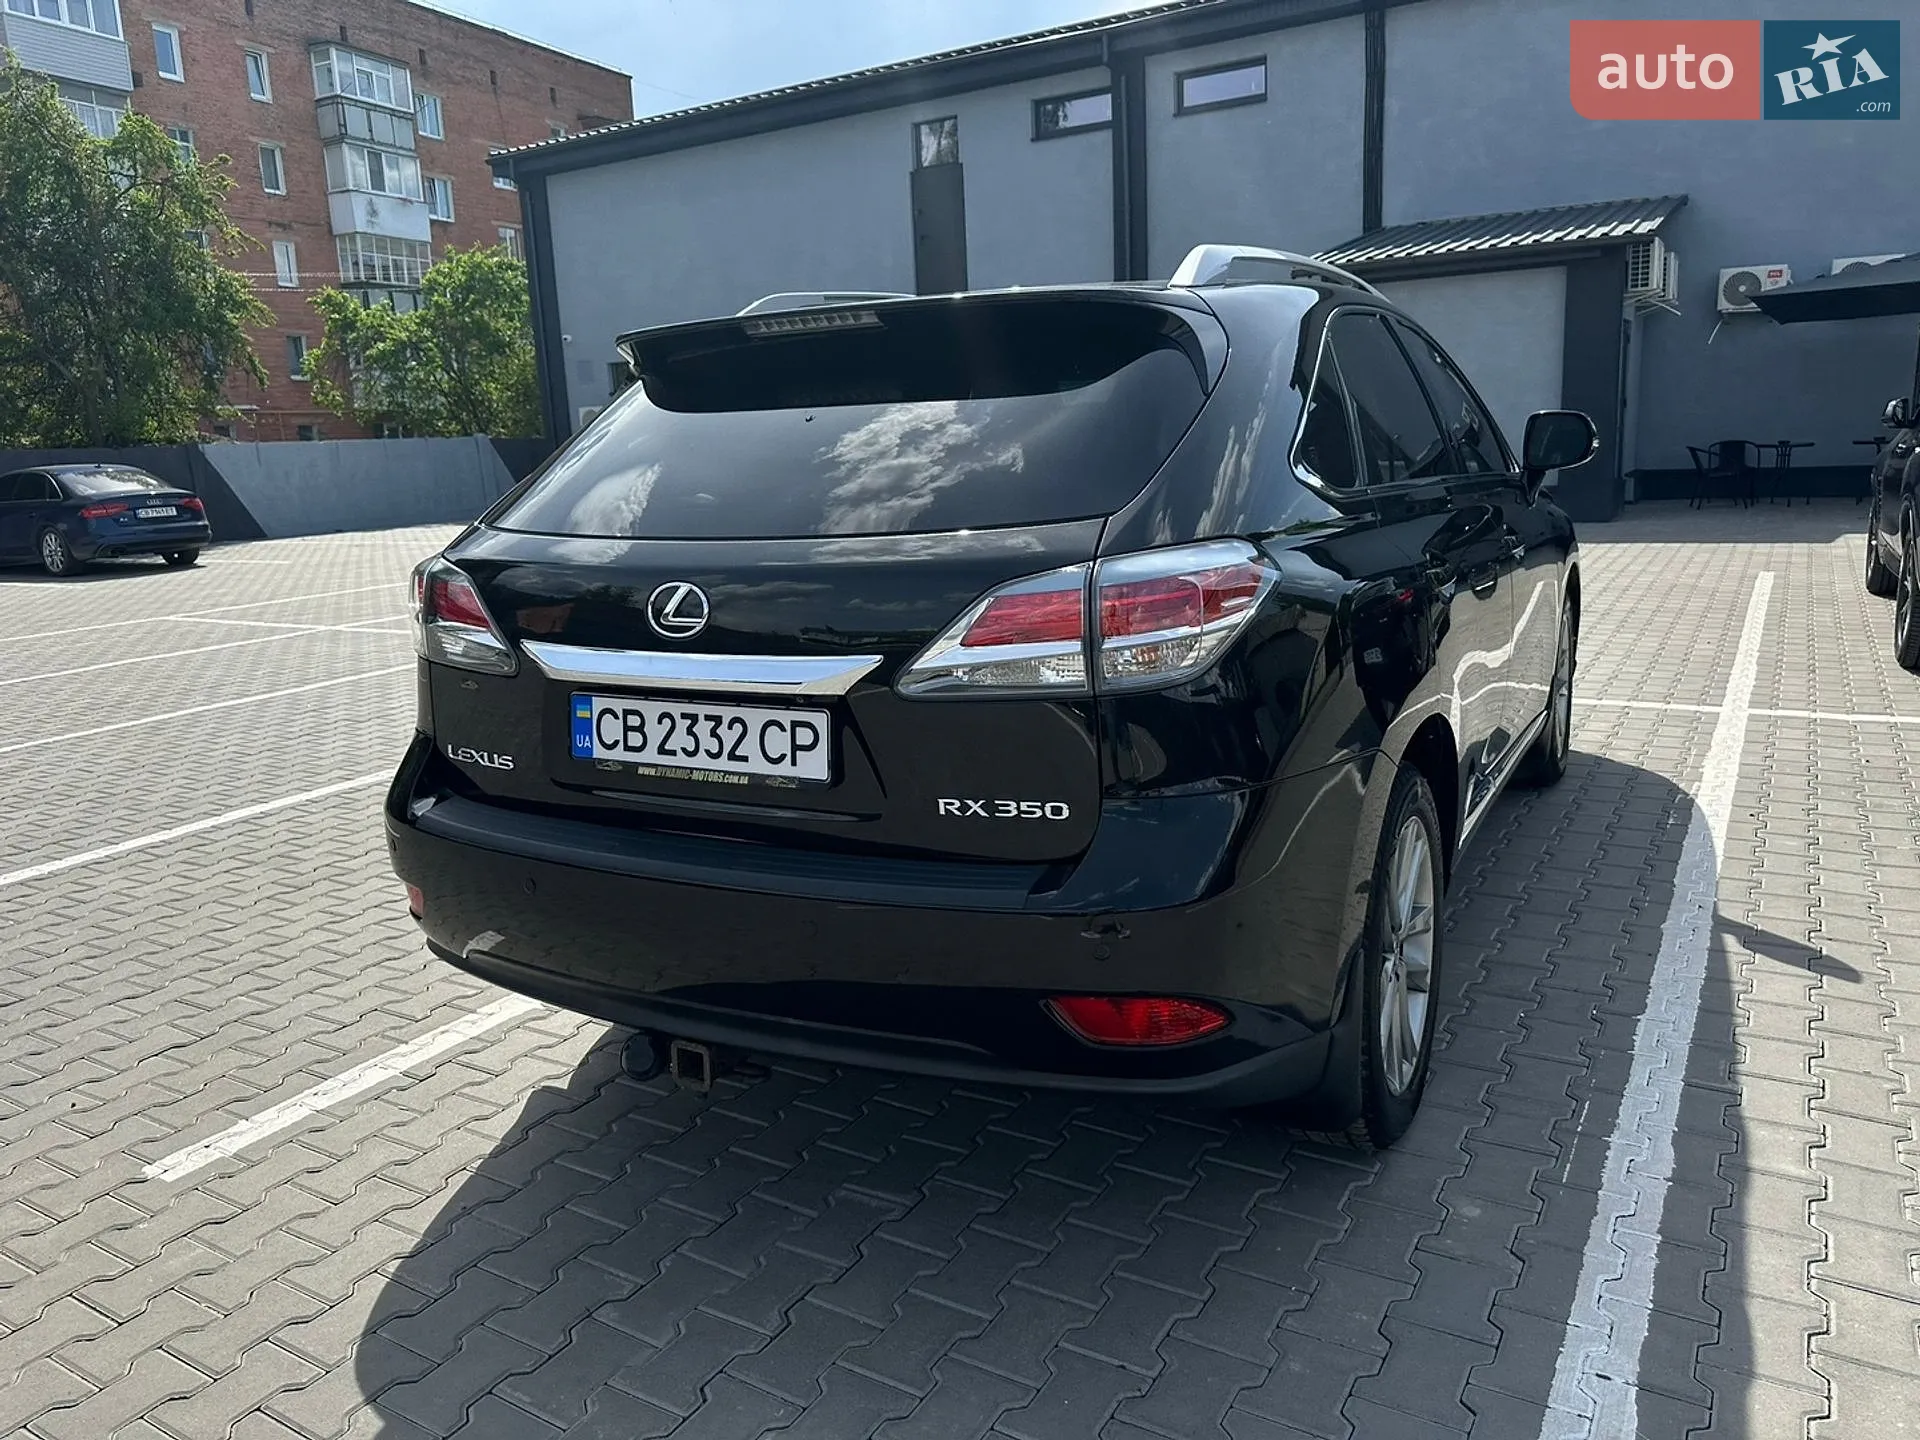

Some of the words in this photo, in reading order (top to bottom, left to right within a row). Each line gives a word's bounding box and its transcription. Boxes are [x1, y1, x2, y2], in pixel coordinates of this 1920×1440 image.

[576, 734, 592, 749] UA
[595, 707, 648, 753] CB
[656, 711, 750, 763] 2332
[758, 719, 820, 767] CP
[447, 743, 515, 771] LEXUS
[937, 798, 990, 818] RX
[993, 799, 1070, 820] 350
